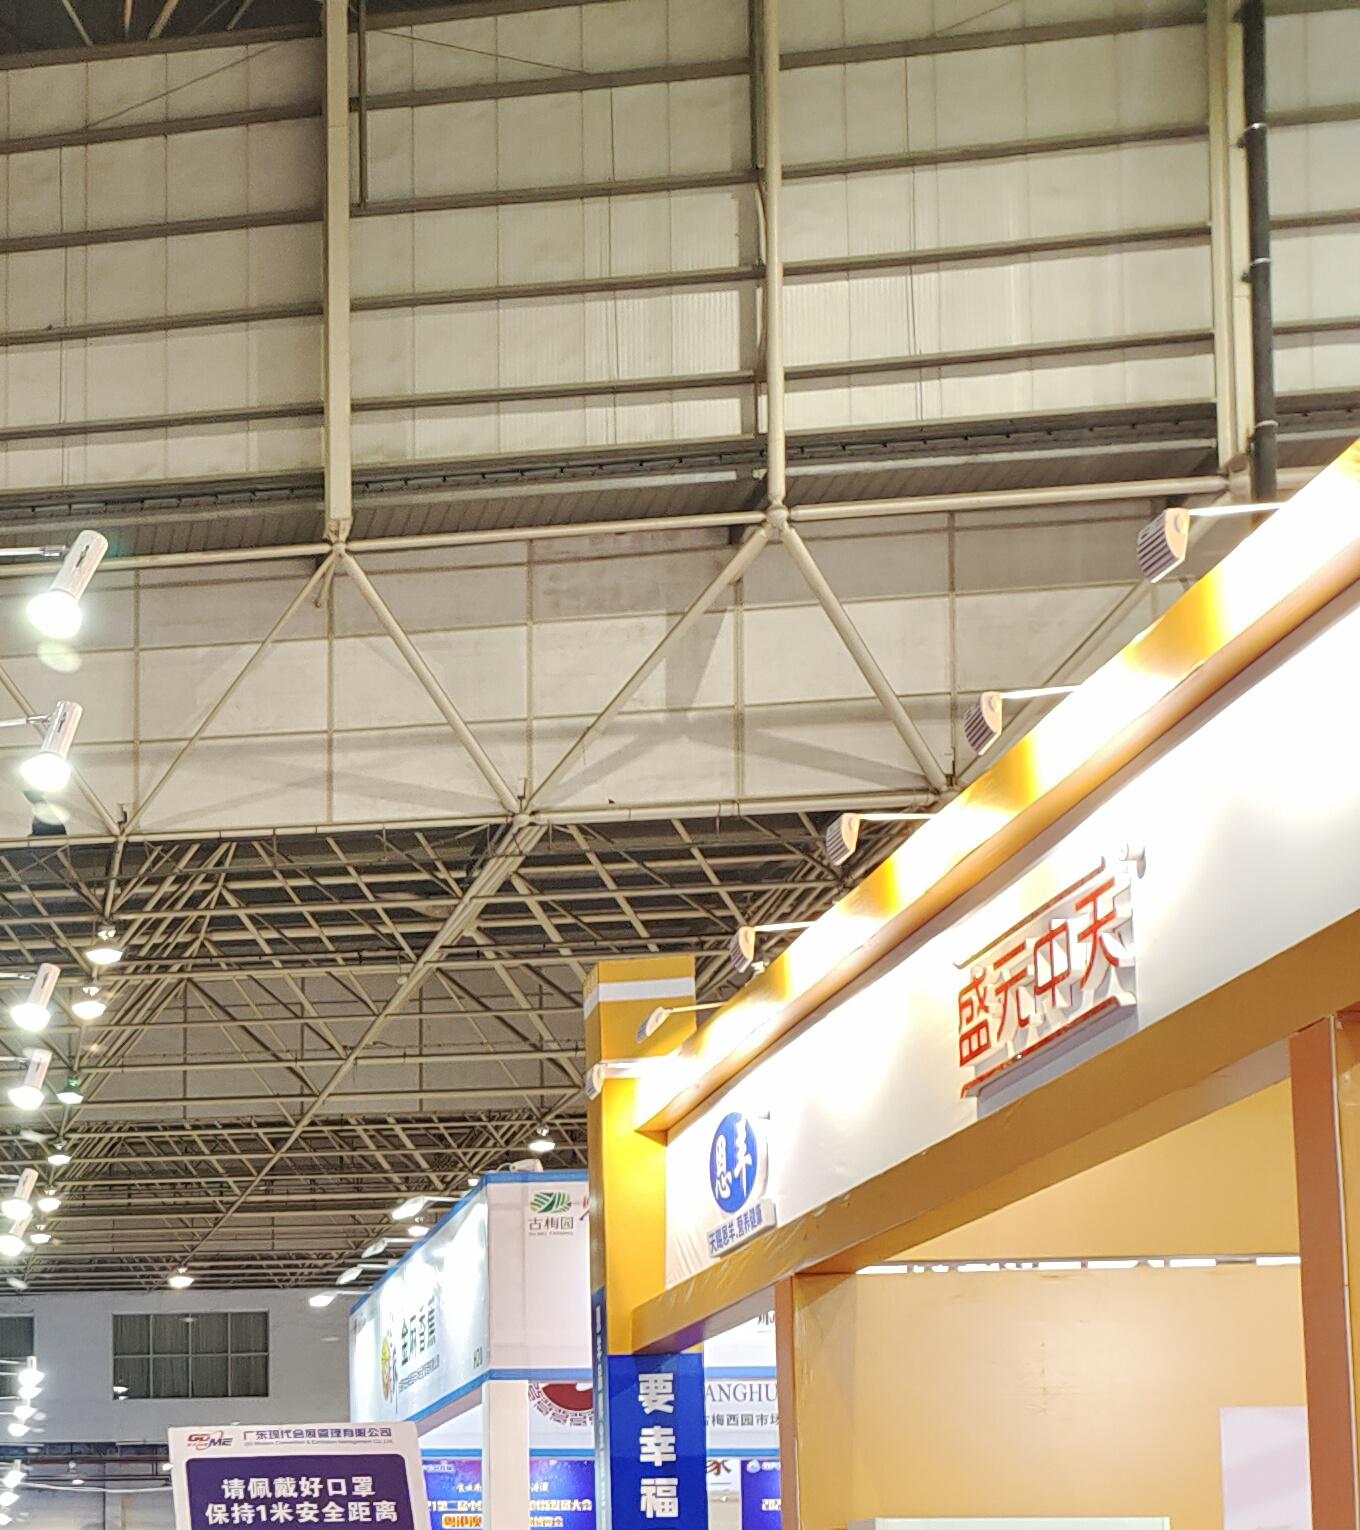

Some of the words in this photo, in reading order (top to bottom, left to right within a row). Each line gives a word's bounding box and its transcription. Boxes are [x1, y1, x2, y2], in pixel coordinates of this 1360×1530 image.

[958, 876, 1117, 1067] 盛元中天
[222, 1476, 376, 1499] 请佩戴好口罩
[205, 1500, 398, 1525] 保持1米安全距离
